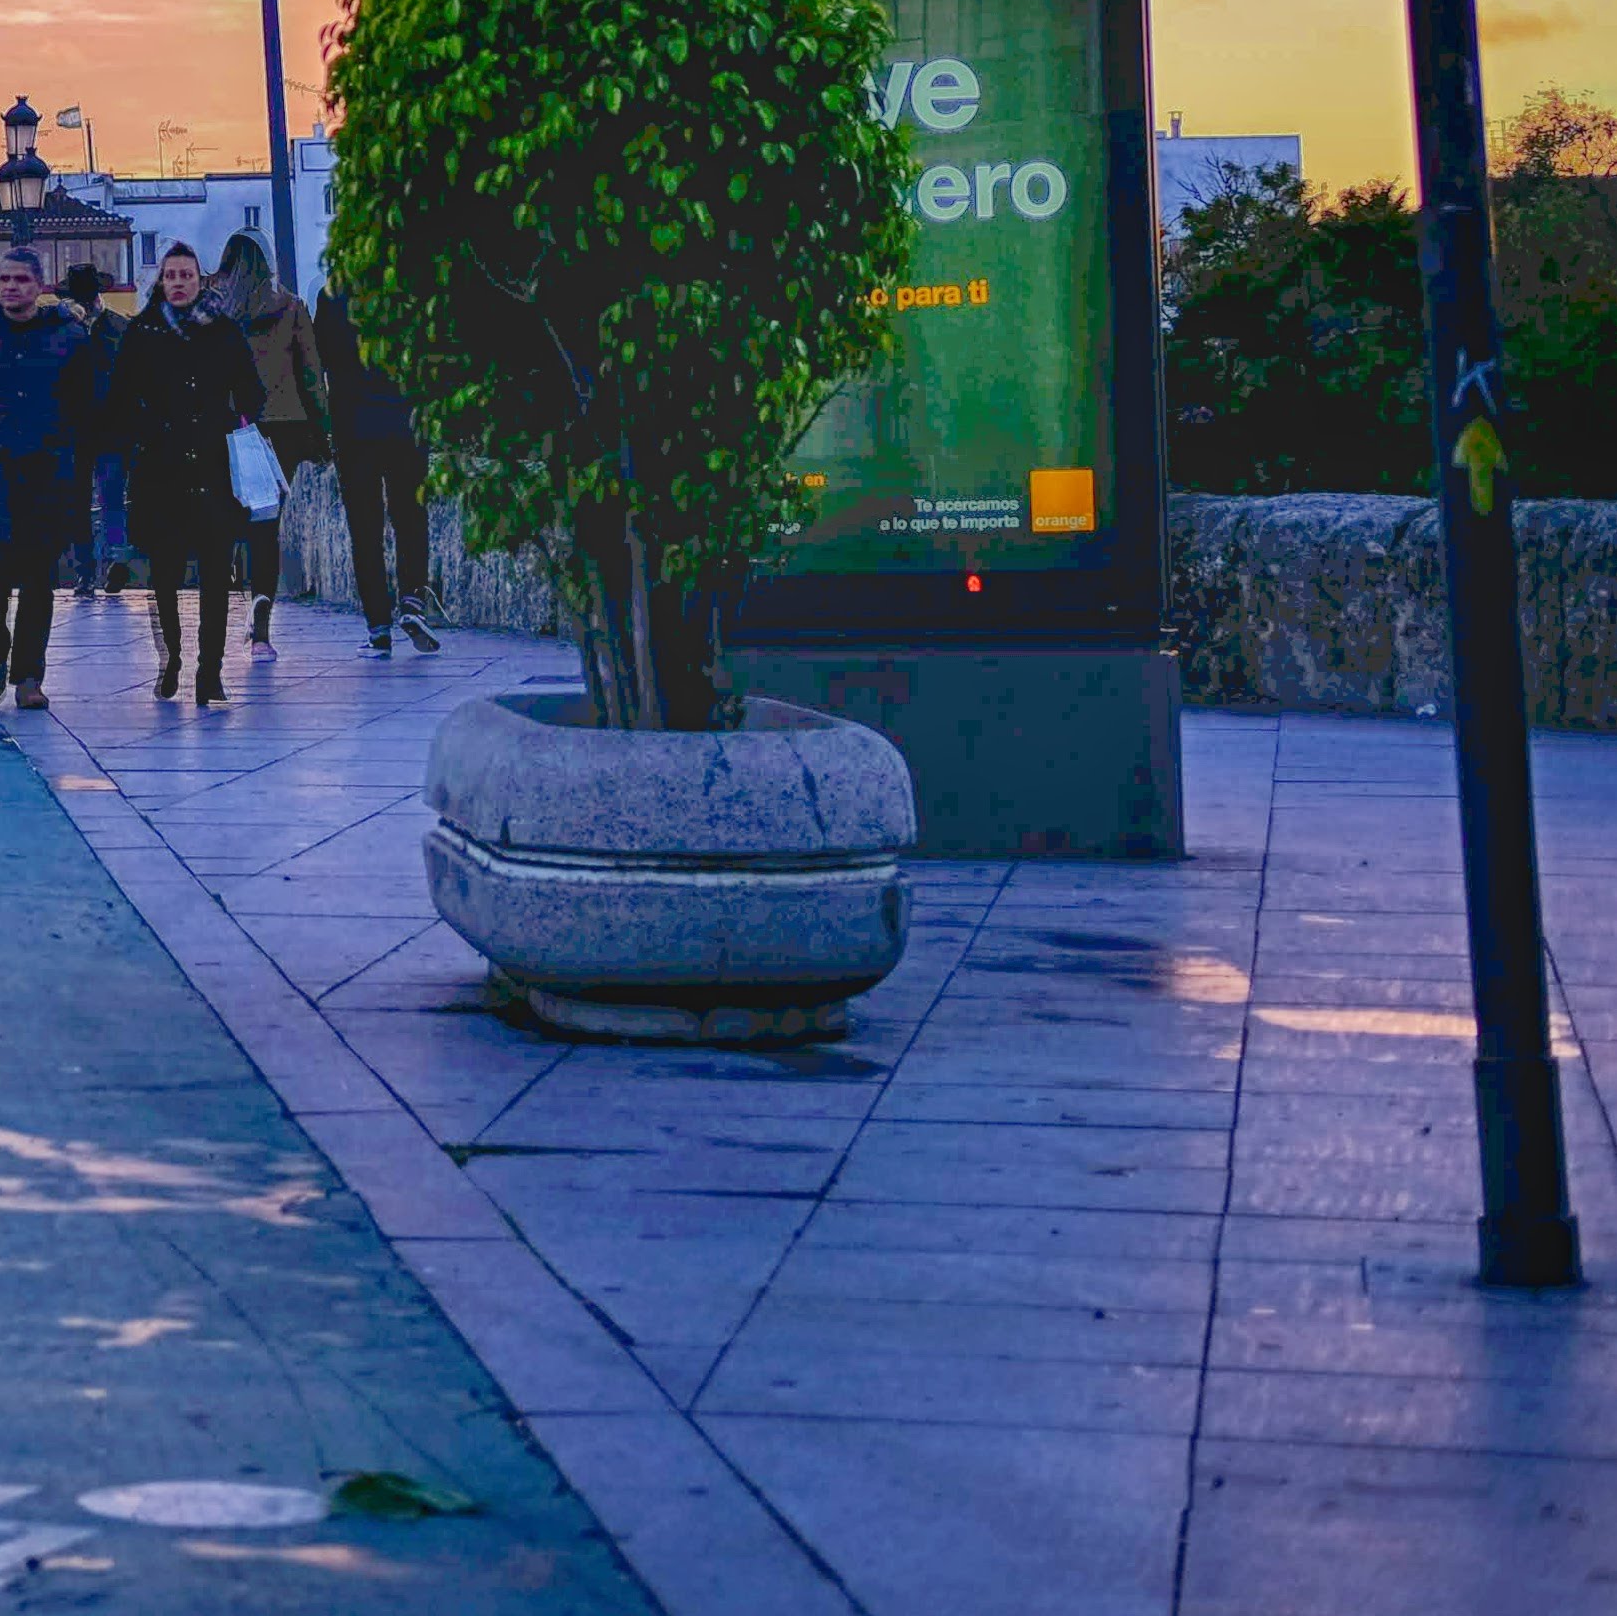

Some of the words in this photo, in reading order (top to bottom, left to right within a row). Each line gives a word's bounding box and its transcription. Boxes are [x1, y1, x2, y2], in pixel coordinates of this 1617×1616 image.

[866, 58, 981, 131] ve
[914, 160, 1068, 221] ero
[895, 285, 962, 311] para
[967, 278, 989, 305] ti
[914, 498, 933, 513] Te
[935, 497, 1020, 512] acercamos
[879, 518, 891, 531] a
[892, 516, 908, 531] lo
[910, 518, 940, 533] que
[942, 516, 958, 530] te
[960, 514, 1020, 532] importa
[1035, 515, 1088, 531] orange
